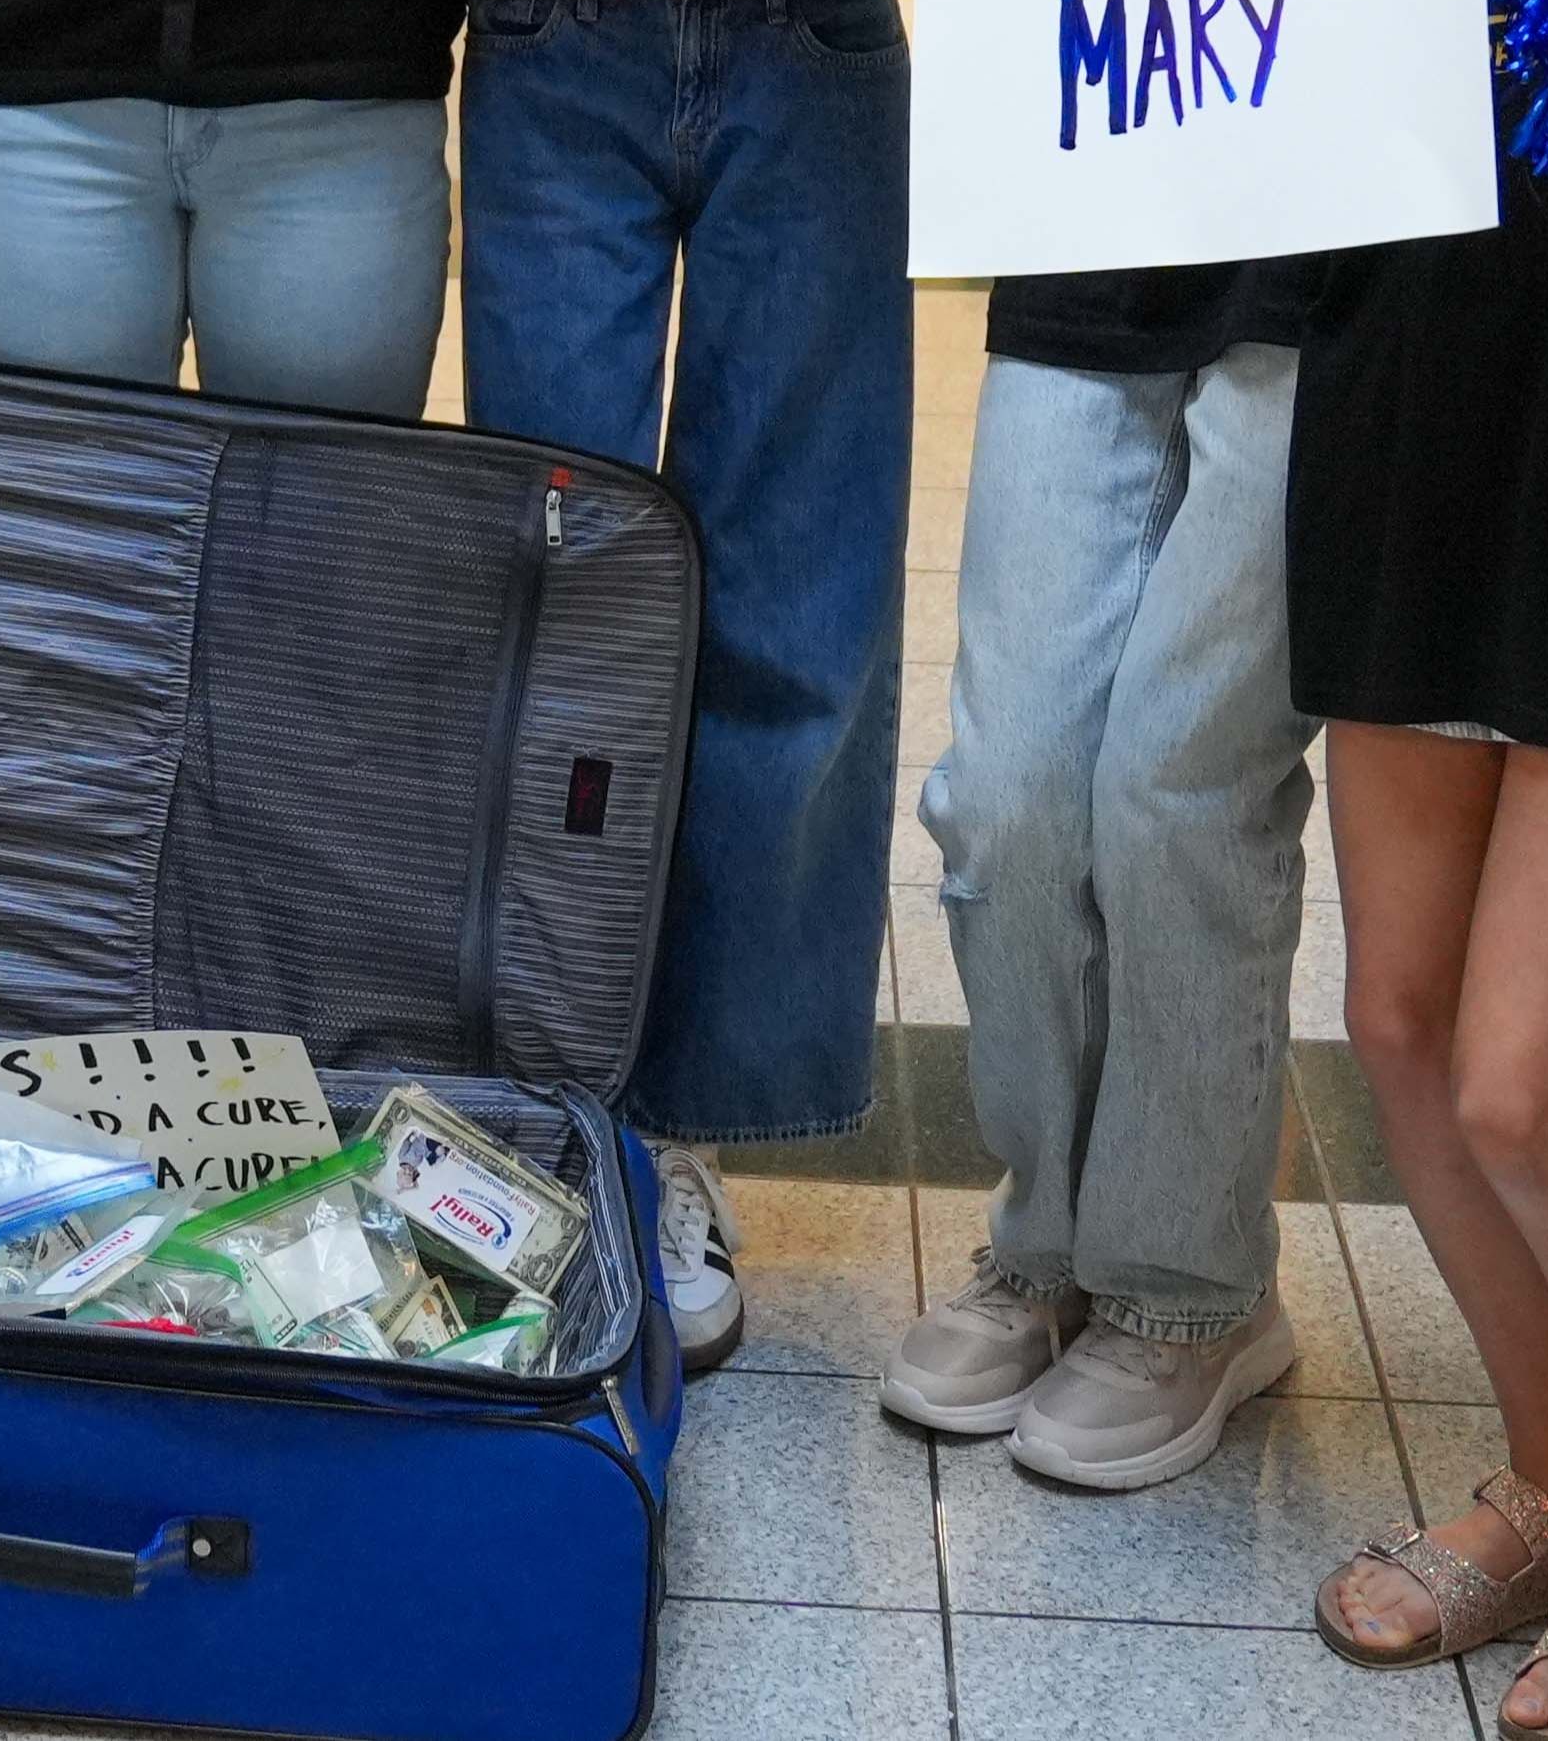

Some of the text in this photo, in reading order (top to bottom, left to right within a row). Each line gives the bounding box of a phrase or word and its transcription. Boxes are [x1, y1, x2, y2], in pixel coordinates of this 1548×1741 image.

[148, 1103, 174, 1132] A
[197, 1097, 328, 1130] CURE,
[156, 1156, 185, 1189] A
[429, 1191, 497, 1240] Rally!
